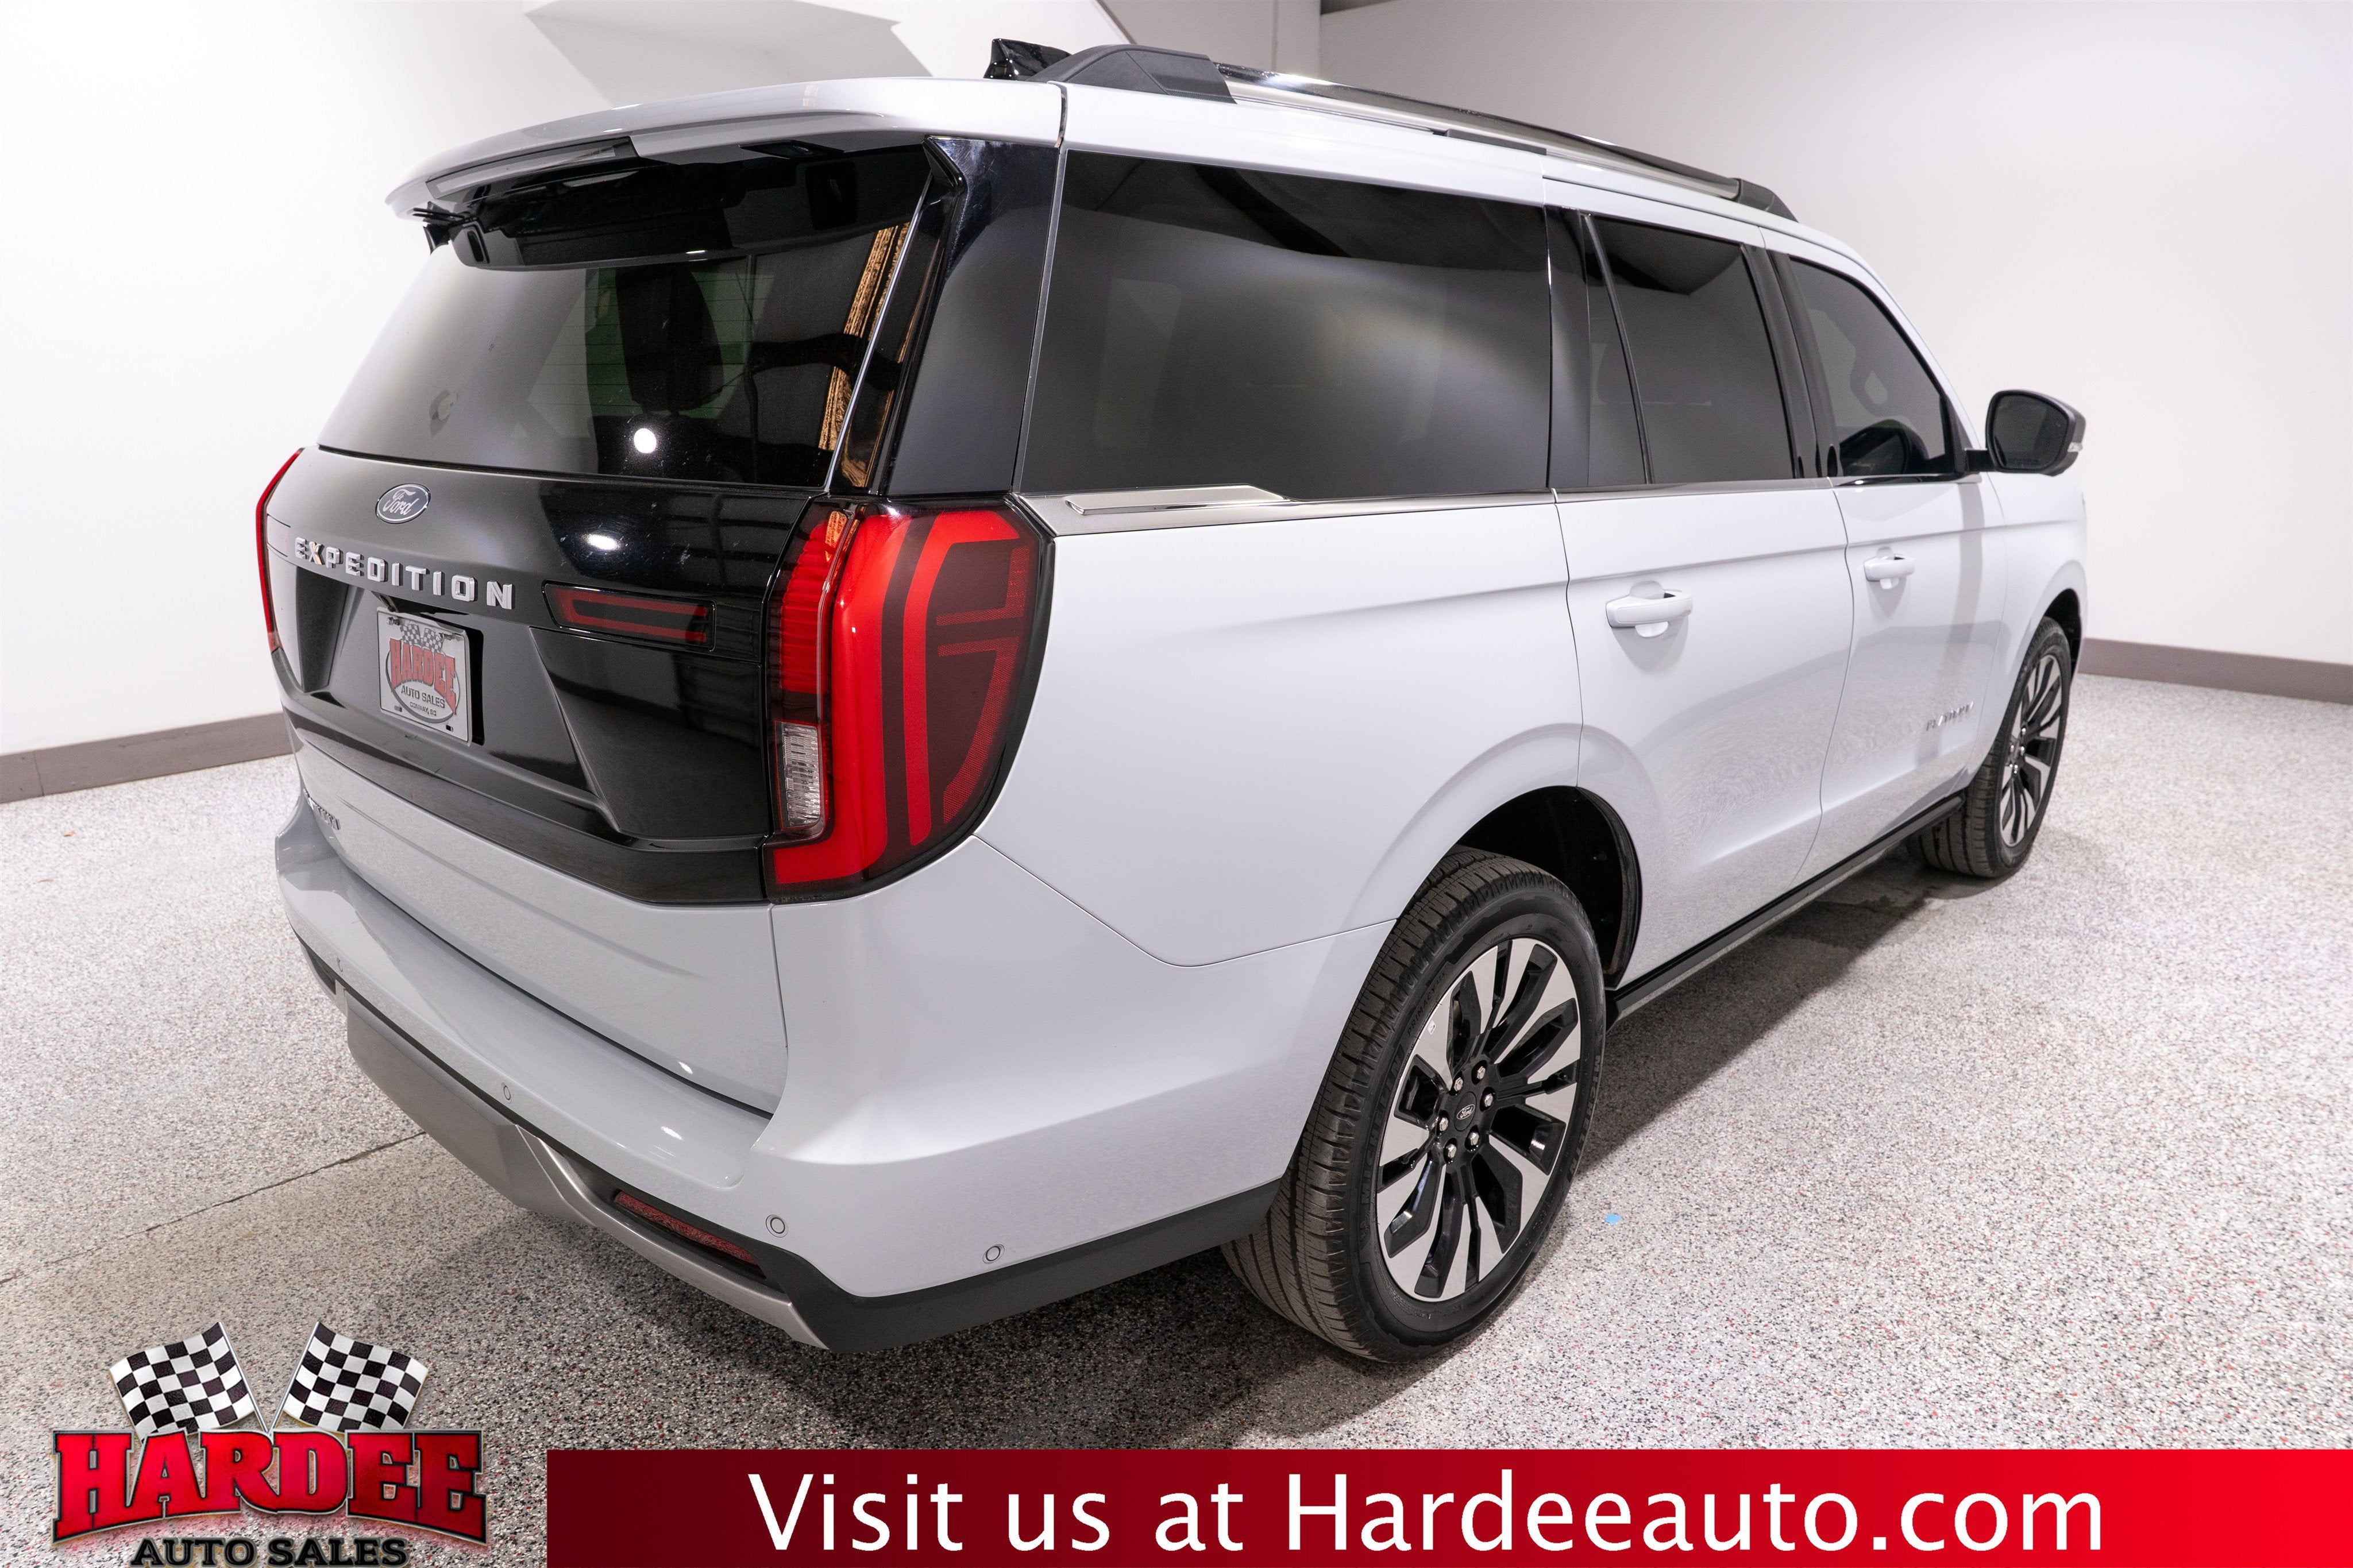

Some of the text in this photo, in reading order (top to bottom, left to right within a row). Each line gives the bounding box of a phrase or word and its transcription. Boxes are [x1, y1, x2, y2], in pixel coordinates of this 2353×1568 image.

[382, 489, 420, 516] Ford
[295, 536, 514, 610] EXPEDITION
[389, 638, 456, 715] HARDEE
[401, 685, 445, 709] AUTO SALES
[1407, 983, 1436, 1036] PRIMACY
[1360, 1053, 1405, 1205] MICHELIN
[1460, 1106, 1473, 1118] Ford
[1568, 1055, 1602, 1176] MICHELIN
